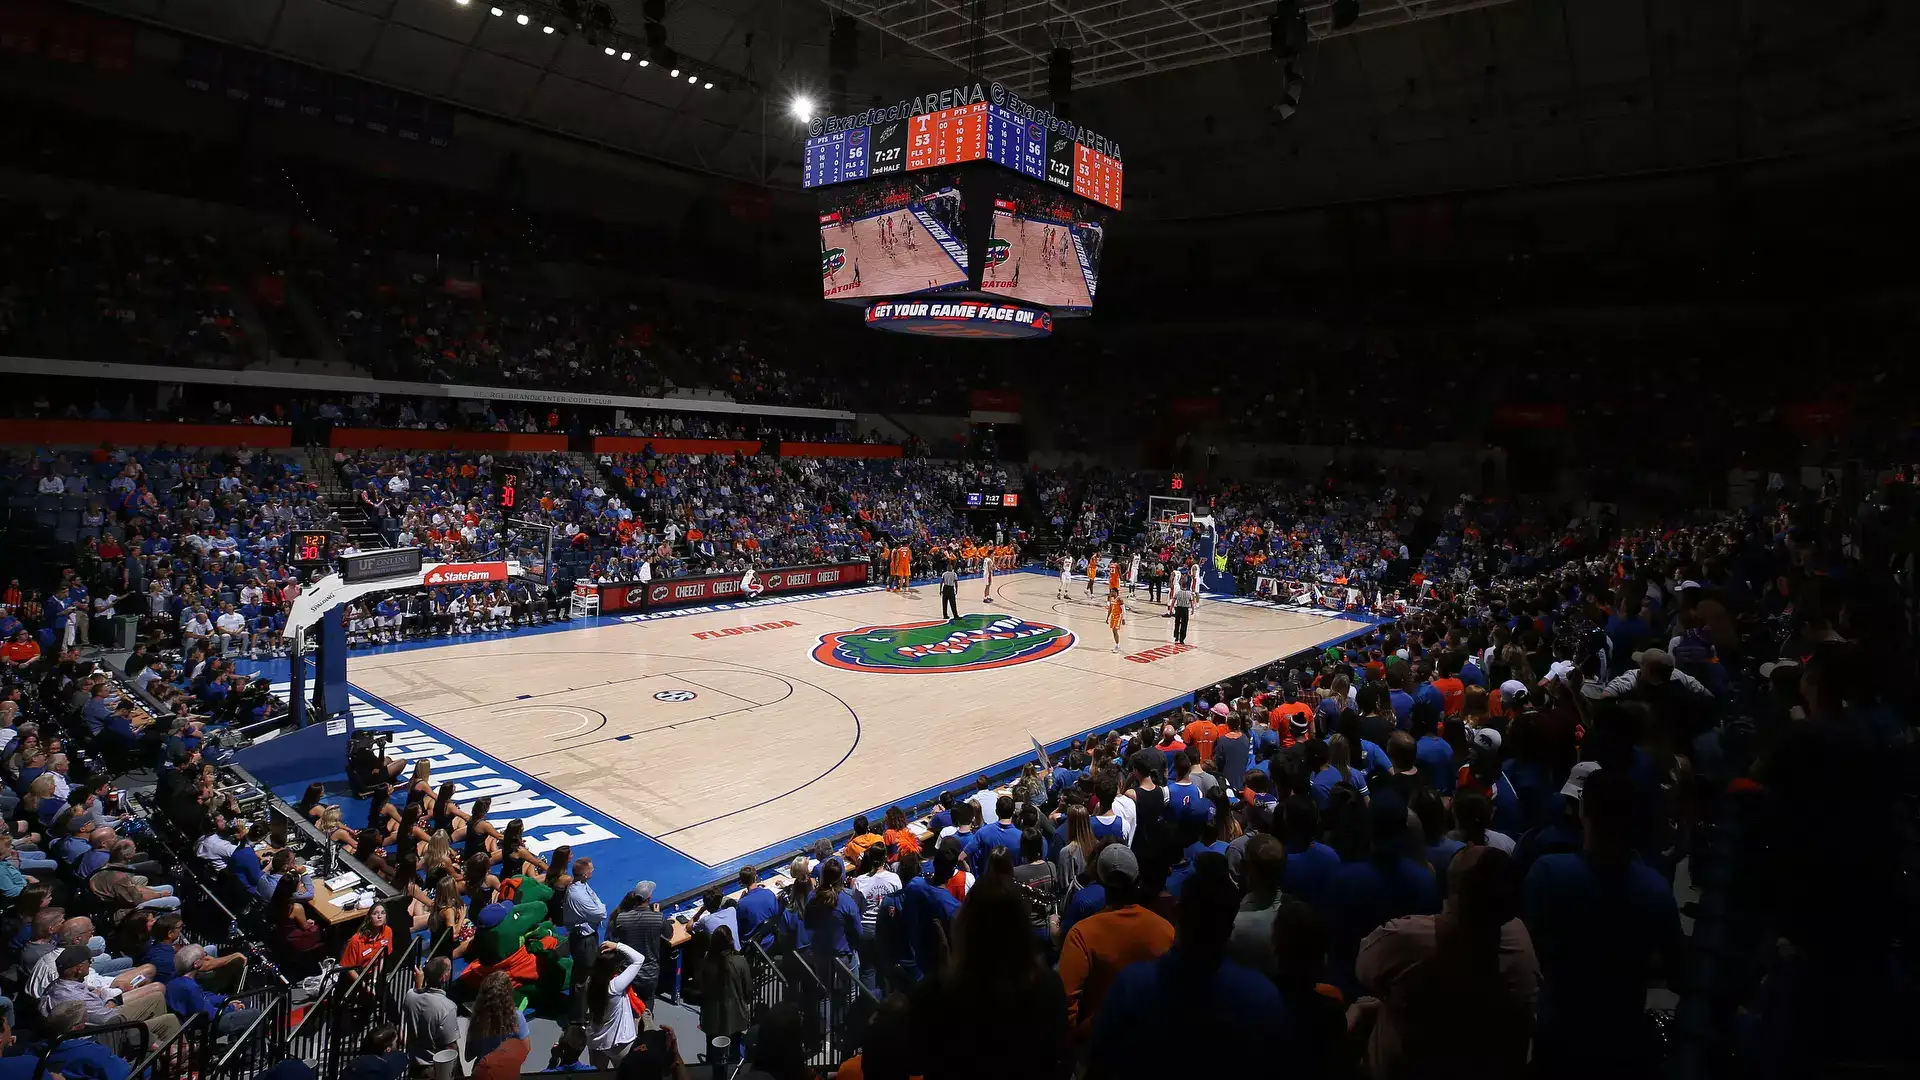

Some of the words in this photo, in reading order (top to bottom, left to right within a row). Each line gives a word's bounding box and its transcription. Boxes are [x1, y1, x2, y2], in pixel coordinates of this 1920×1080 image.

[824, 100, 911, 136] Exactech
[910, 83, 984, 117] ARENA
[954, 108, 967, 116] PTS
[1000, 109, 1010, 119] PTS
[1014, 116, 1023, 125] FLS
[1006, 92, 1076, 140] Exactech
[1075, 126, 1122, 162] ARENA
[915, 134, 930, 146] 53
[988, 133, 994, 141] 10
[849, 147, 863, 159] 56
[875, 148, 900, 162] 7:27
[1029, 142, 1040, 155] 56
[1026, 155, 1035, 164] FLS
[884, 164, 900, 173] HALF
[1026, 165, 1036, 174] TOL
[1050, 159, 1070, 176] 7:27
[1079, 164, 1089, 176] 53
[824, 281, 860, 296] GATORS
[875, 305, 892, 317] GET
[894, 304, 928, 316] YOUR
[930, 305, 976, 318] GAME
[978, 306, 1014, 320] FACE
[1015, 310, 1034, 323] ON!
[1172, 479, 1182, 489] 30
[501, 487, 514, 507] 30
[303, 536, 325, 545] 7:27
[301, 546, 318, 559] 30
[359, 559, 375, 570] UF
[376, 556, 410, 566] ONLINE
[675, 584, 705, 598] CHEEZ-IT
[712, 580, 740, 594] CHEEZ-IT
[787, 574, 811, 586] CHEEZ-IT
[817, 570, 840, 583] CHEEZ-IT
[310, 593, 336, 612] SPALDING
[620, 606, 714, 621] STEPHEN
[690, 620, 801, 640] FLORIDA
